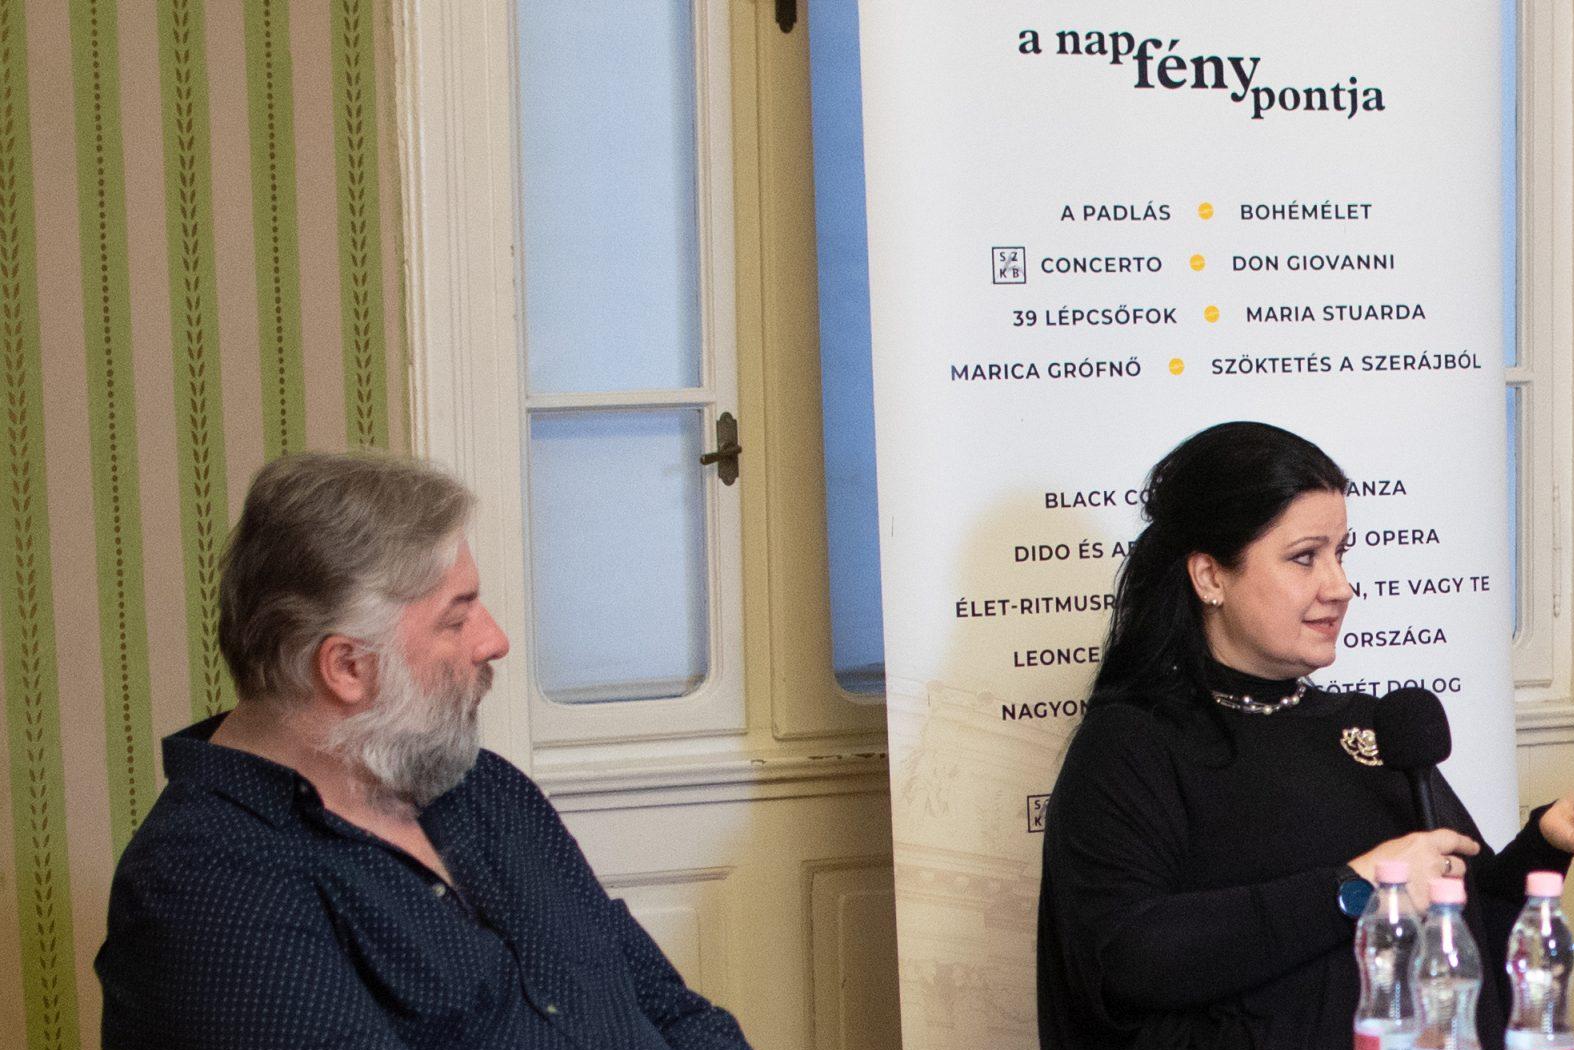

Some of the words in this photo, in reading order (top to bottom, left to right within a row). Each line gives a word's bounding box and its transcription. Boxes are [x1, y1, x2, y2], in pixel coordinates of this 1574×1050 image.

[1018, 29, 1042, 55] a
[1056, 30, 1136, 65] nap
[1133, 38, 1261, 102] fény
[1251, 76, 1386, 120] pontja
[1060, 205, 1075, 222] A
[1083, 201, 1171, 221] PADLÁS
[1240, 201, 1372, 220] BOHÉMÉLET
[1040, 256, 1162, 274] CONCERTO
[1232, 256, 1279, 272] DON
[1286, 254, 1395, 271] GIOVANNI
[1013, 310, 1038, 327] 39
[1045, 304, 1177, 326] LÉPCSŐFOK
[1246, 306, 1316, 323] MARIA
[1322, 304, 1426, 322] STUARDA
[951, 362, 1041, 381] MARICA
[1047, 357, 1141, 379] GRÓFNŐ
[1211, 353, 1334, 375] SZÖKTETÉS
[1339, 356, 1354, 372] A
[1361, 350, 1482, 372] SZERÁJBÓL
[1045, 490, 1117, 508] BLACK
[1365, 528, 1440, 547] OPERA
[1014, 543, 1071, 562] DIDO
[1078, 538, 1104, 560] ÉS
[1375, 580, 1400, 596] TE
[1407, 577, 1464, 595] VAGY
[1470, 575, 1490, 592] TE
[1343, 625, 1447, 649] ORSZÁGA
[1013, 646, 1100, 668] LEONCE
